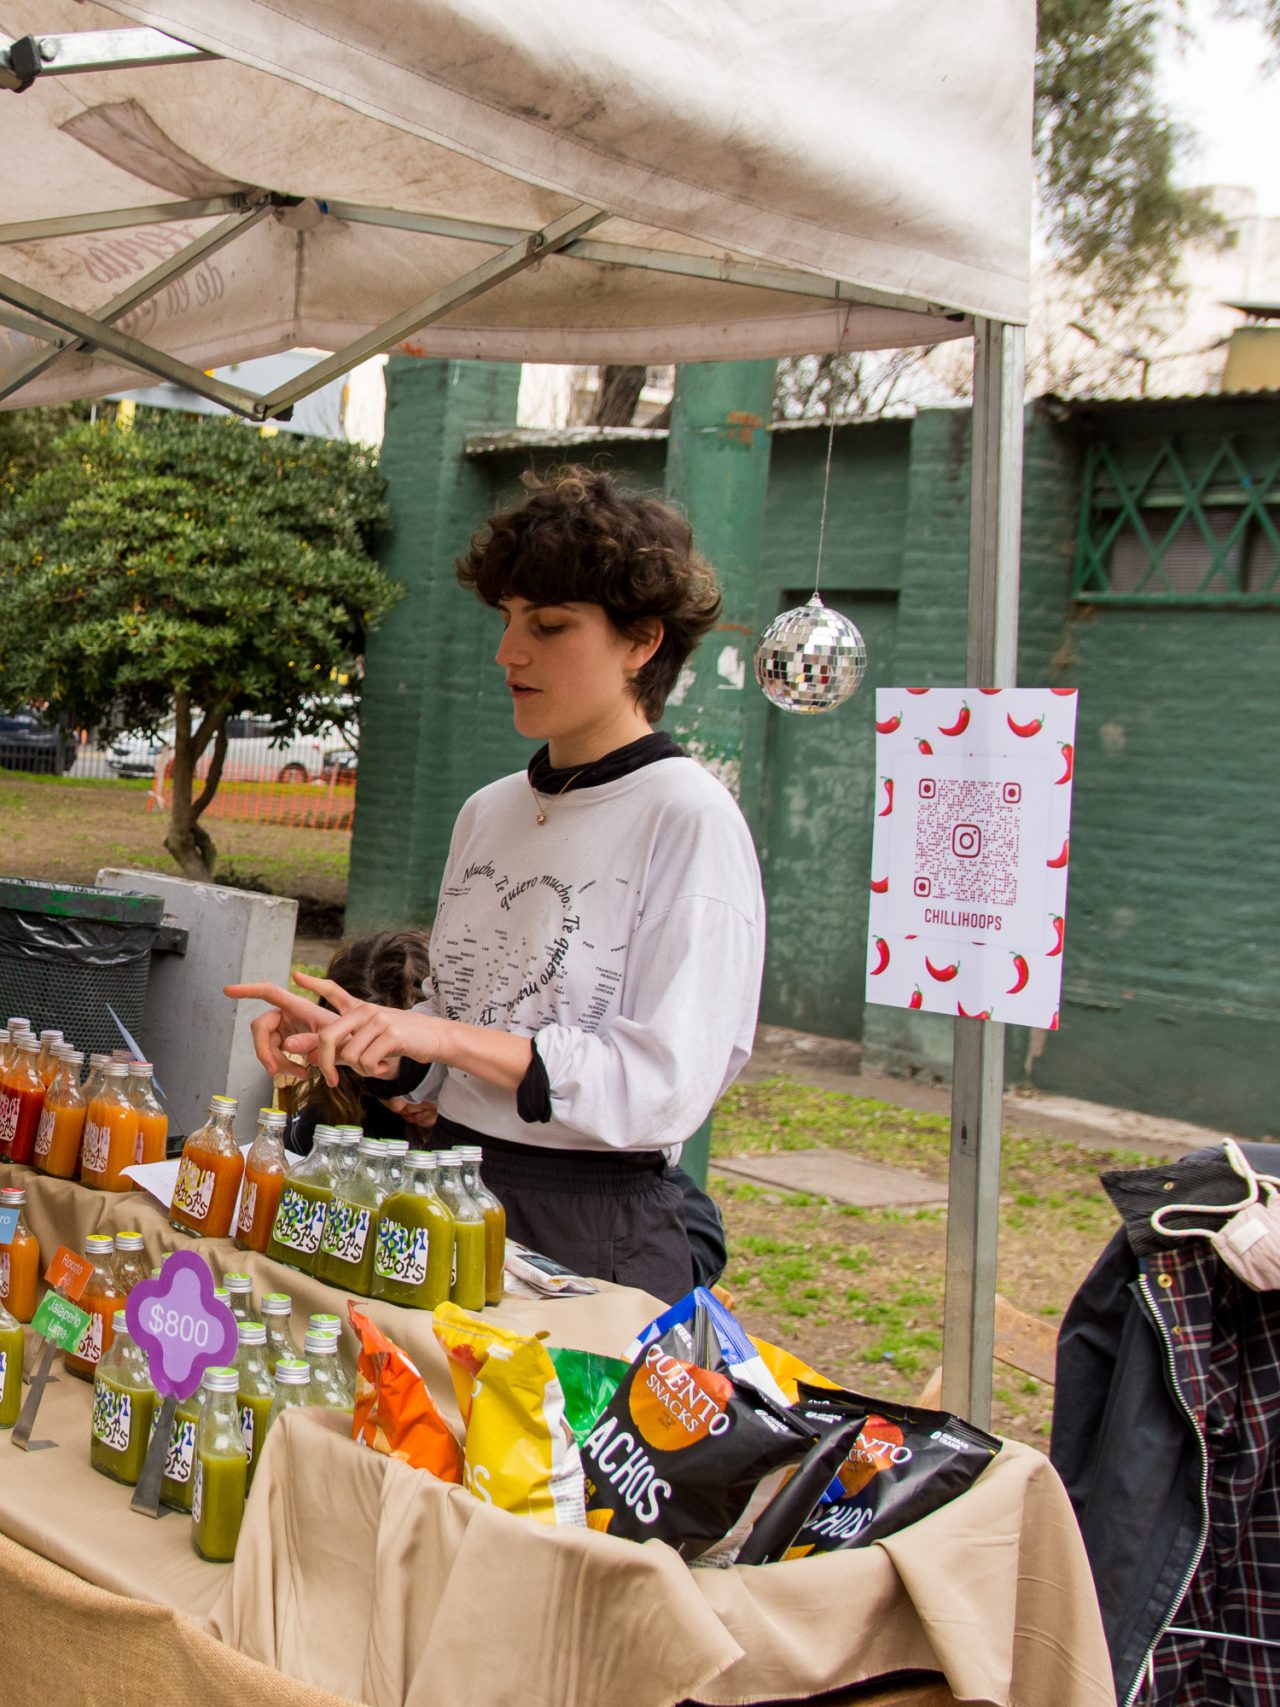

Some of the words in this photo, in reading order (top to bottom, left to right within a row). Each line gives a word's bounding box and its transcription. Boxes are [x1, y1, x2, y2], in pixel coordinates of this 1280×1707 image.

[495, 875, 509, 893] Te
[500, 876, 538, 912] quiero
[562, 915, 580, 934] Te
[924, 908, 1002, 931] CHILLIHOOPS
[47, 1300, 82, 1329] Jalapeño
[148, 1303, 209, 1347] $800
[645, 1344, 730, 1436] QUENTO
[646, 1373, 699, 1433] SNACKS
[583, 1416, 672, 1524] ACHOS
